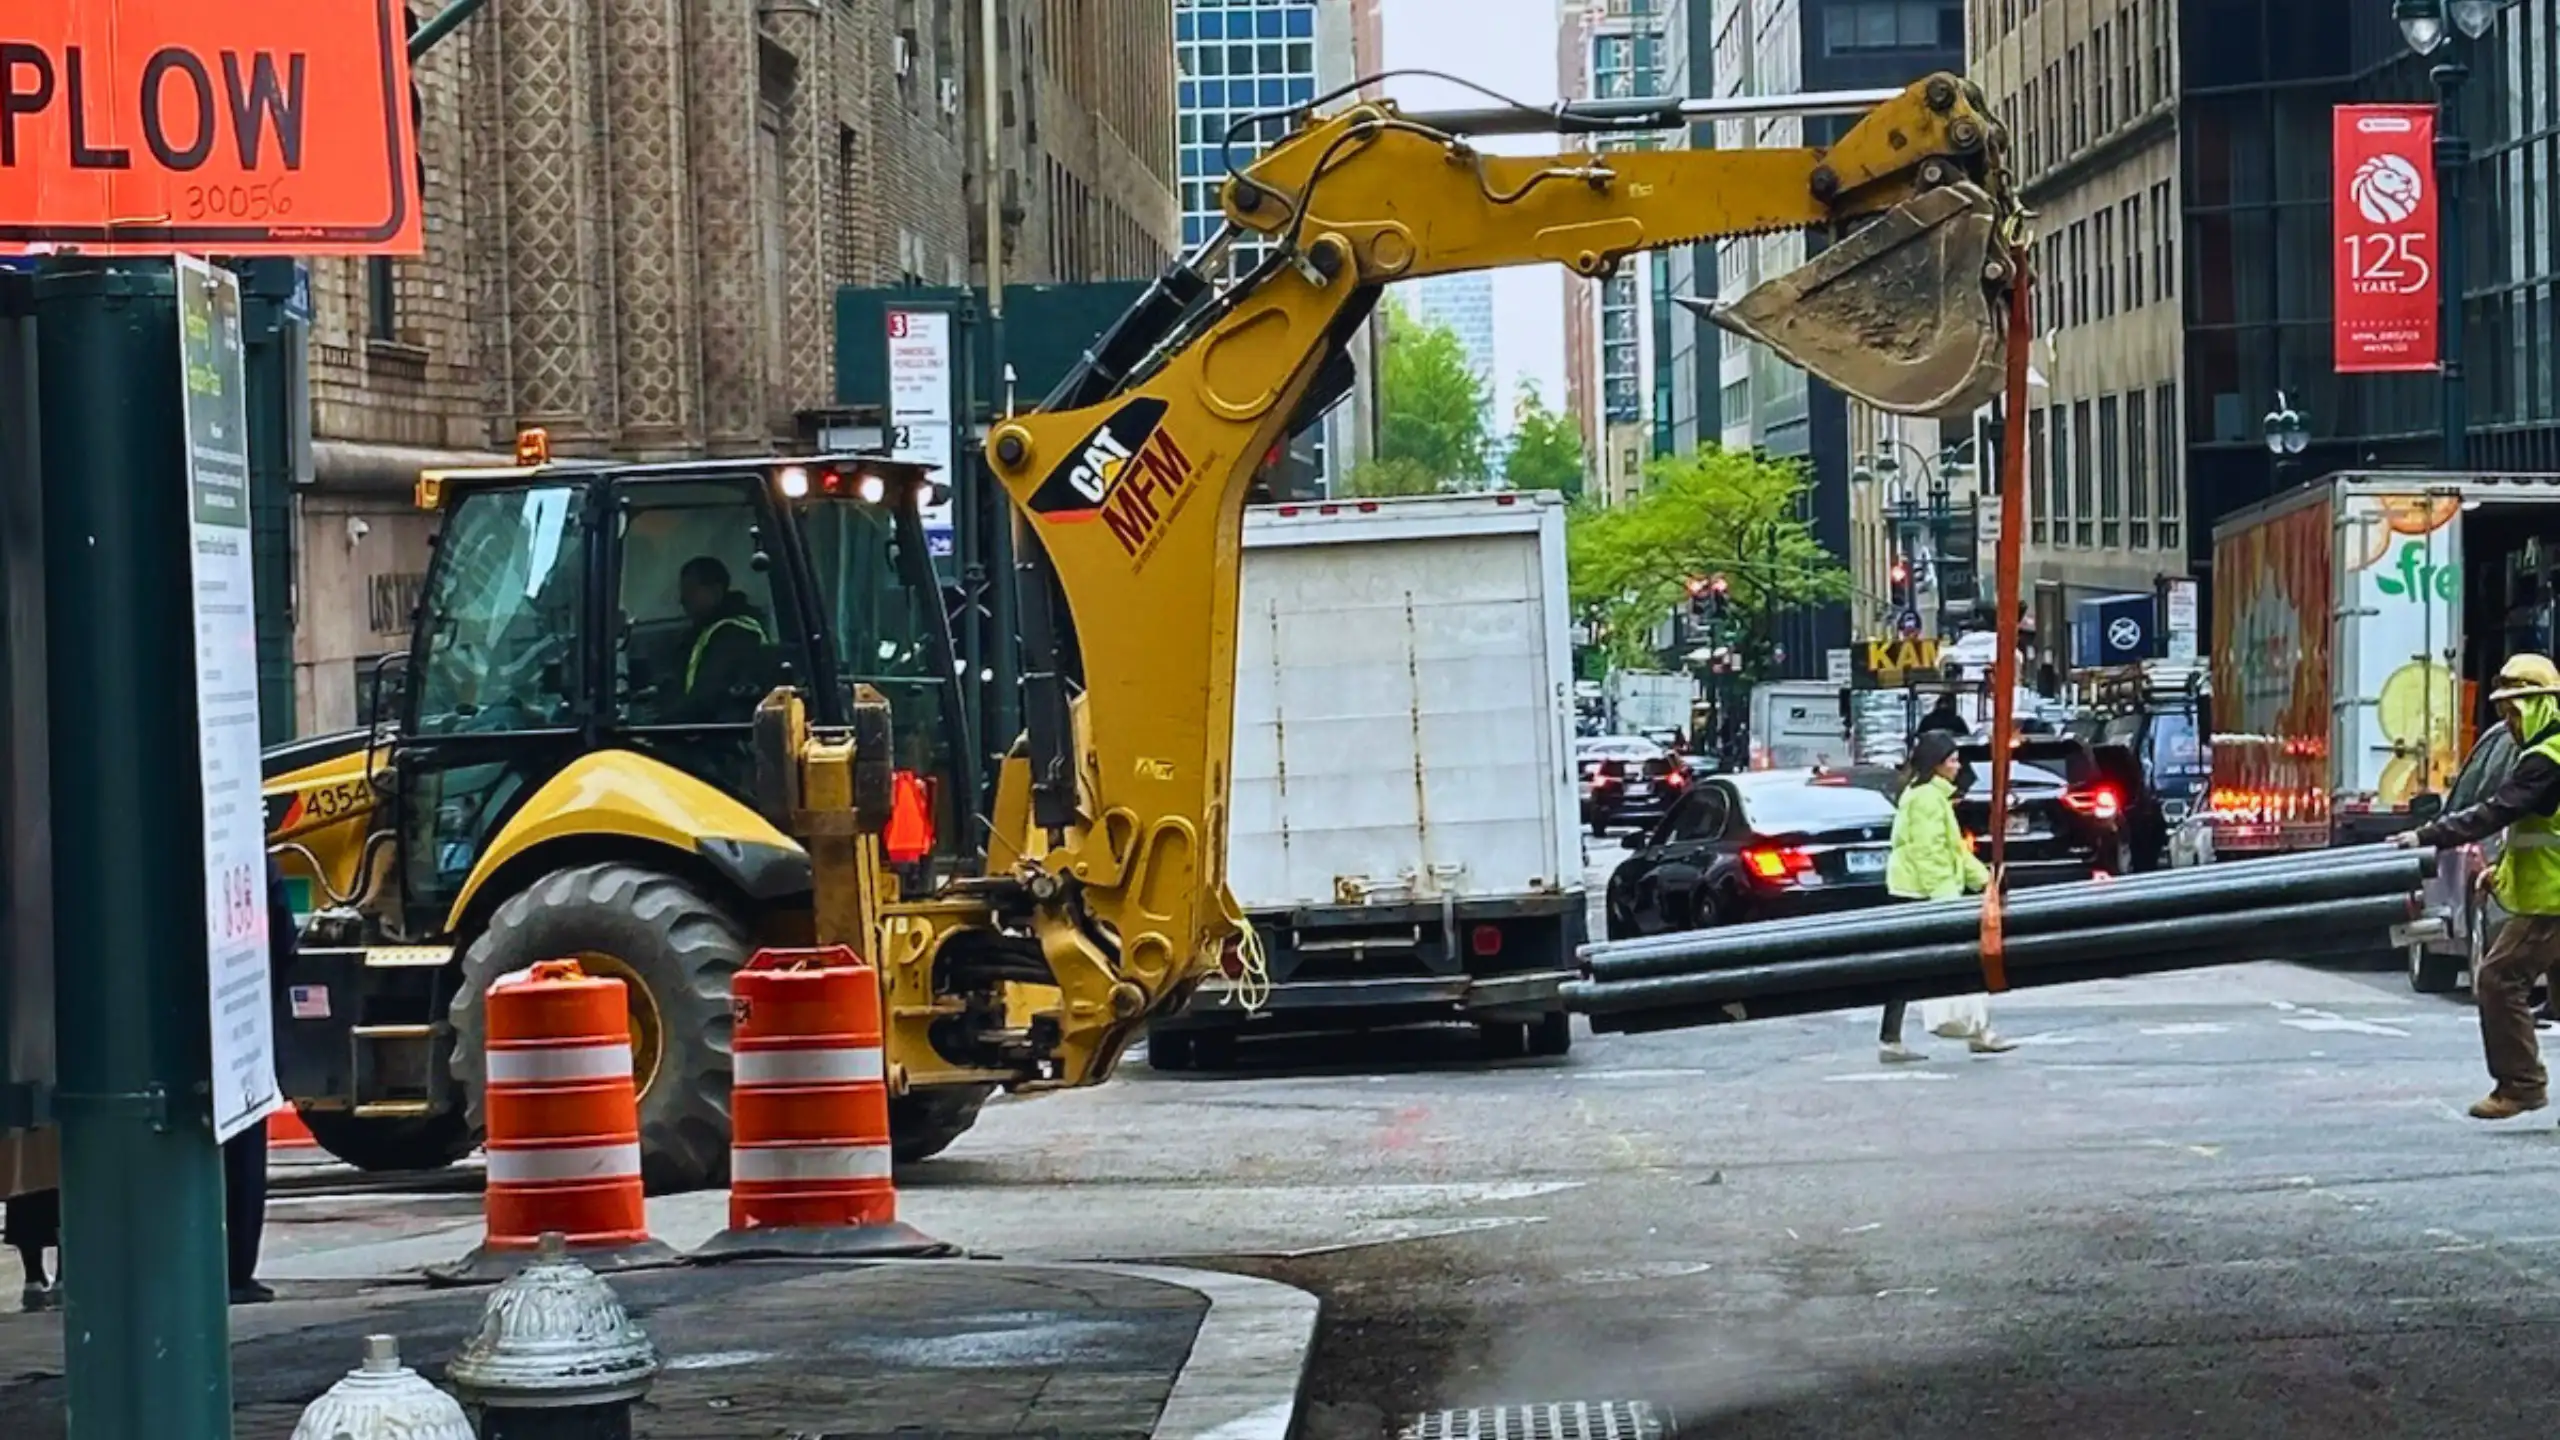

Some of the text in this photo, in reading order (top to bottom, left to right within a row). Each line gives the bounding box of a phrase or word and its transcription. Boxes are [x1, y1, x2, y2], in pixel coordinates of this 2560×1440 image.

[0, 42, 305, 172] PLOW
[186, 176, 292, 221] 30056
[2343, 232, 2430, 294] 125
[2352, 280, 2398, 293] YEARS
[892, 314, 907, 338] 3
[894, 426, 908, 449] 2
[1069, 425, 1133, 503] CAT
[1101, 427, 1193, 557] MFM
[306, 780, 371, 820] 4354
